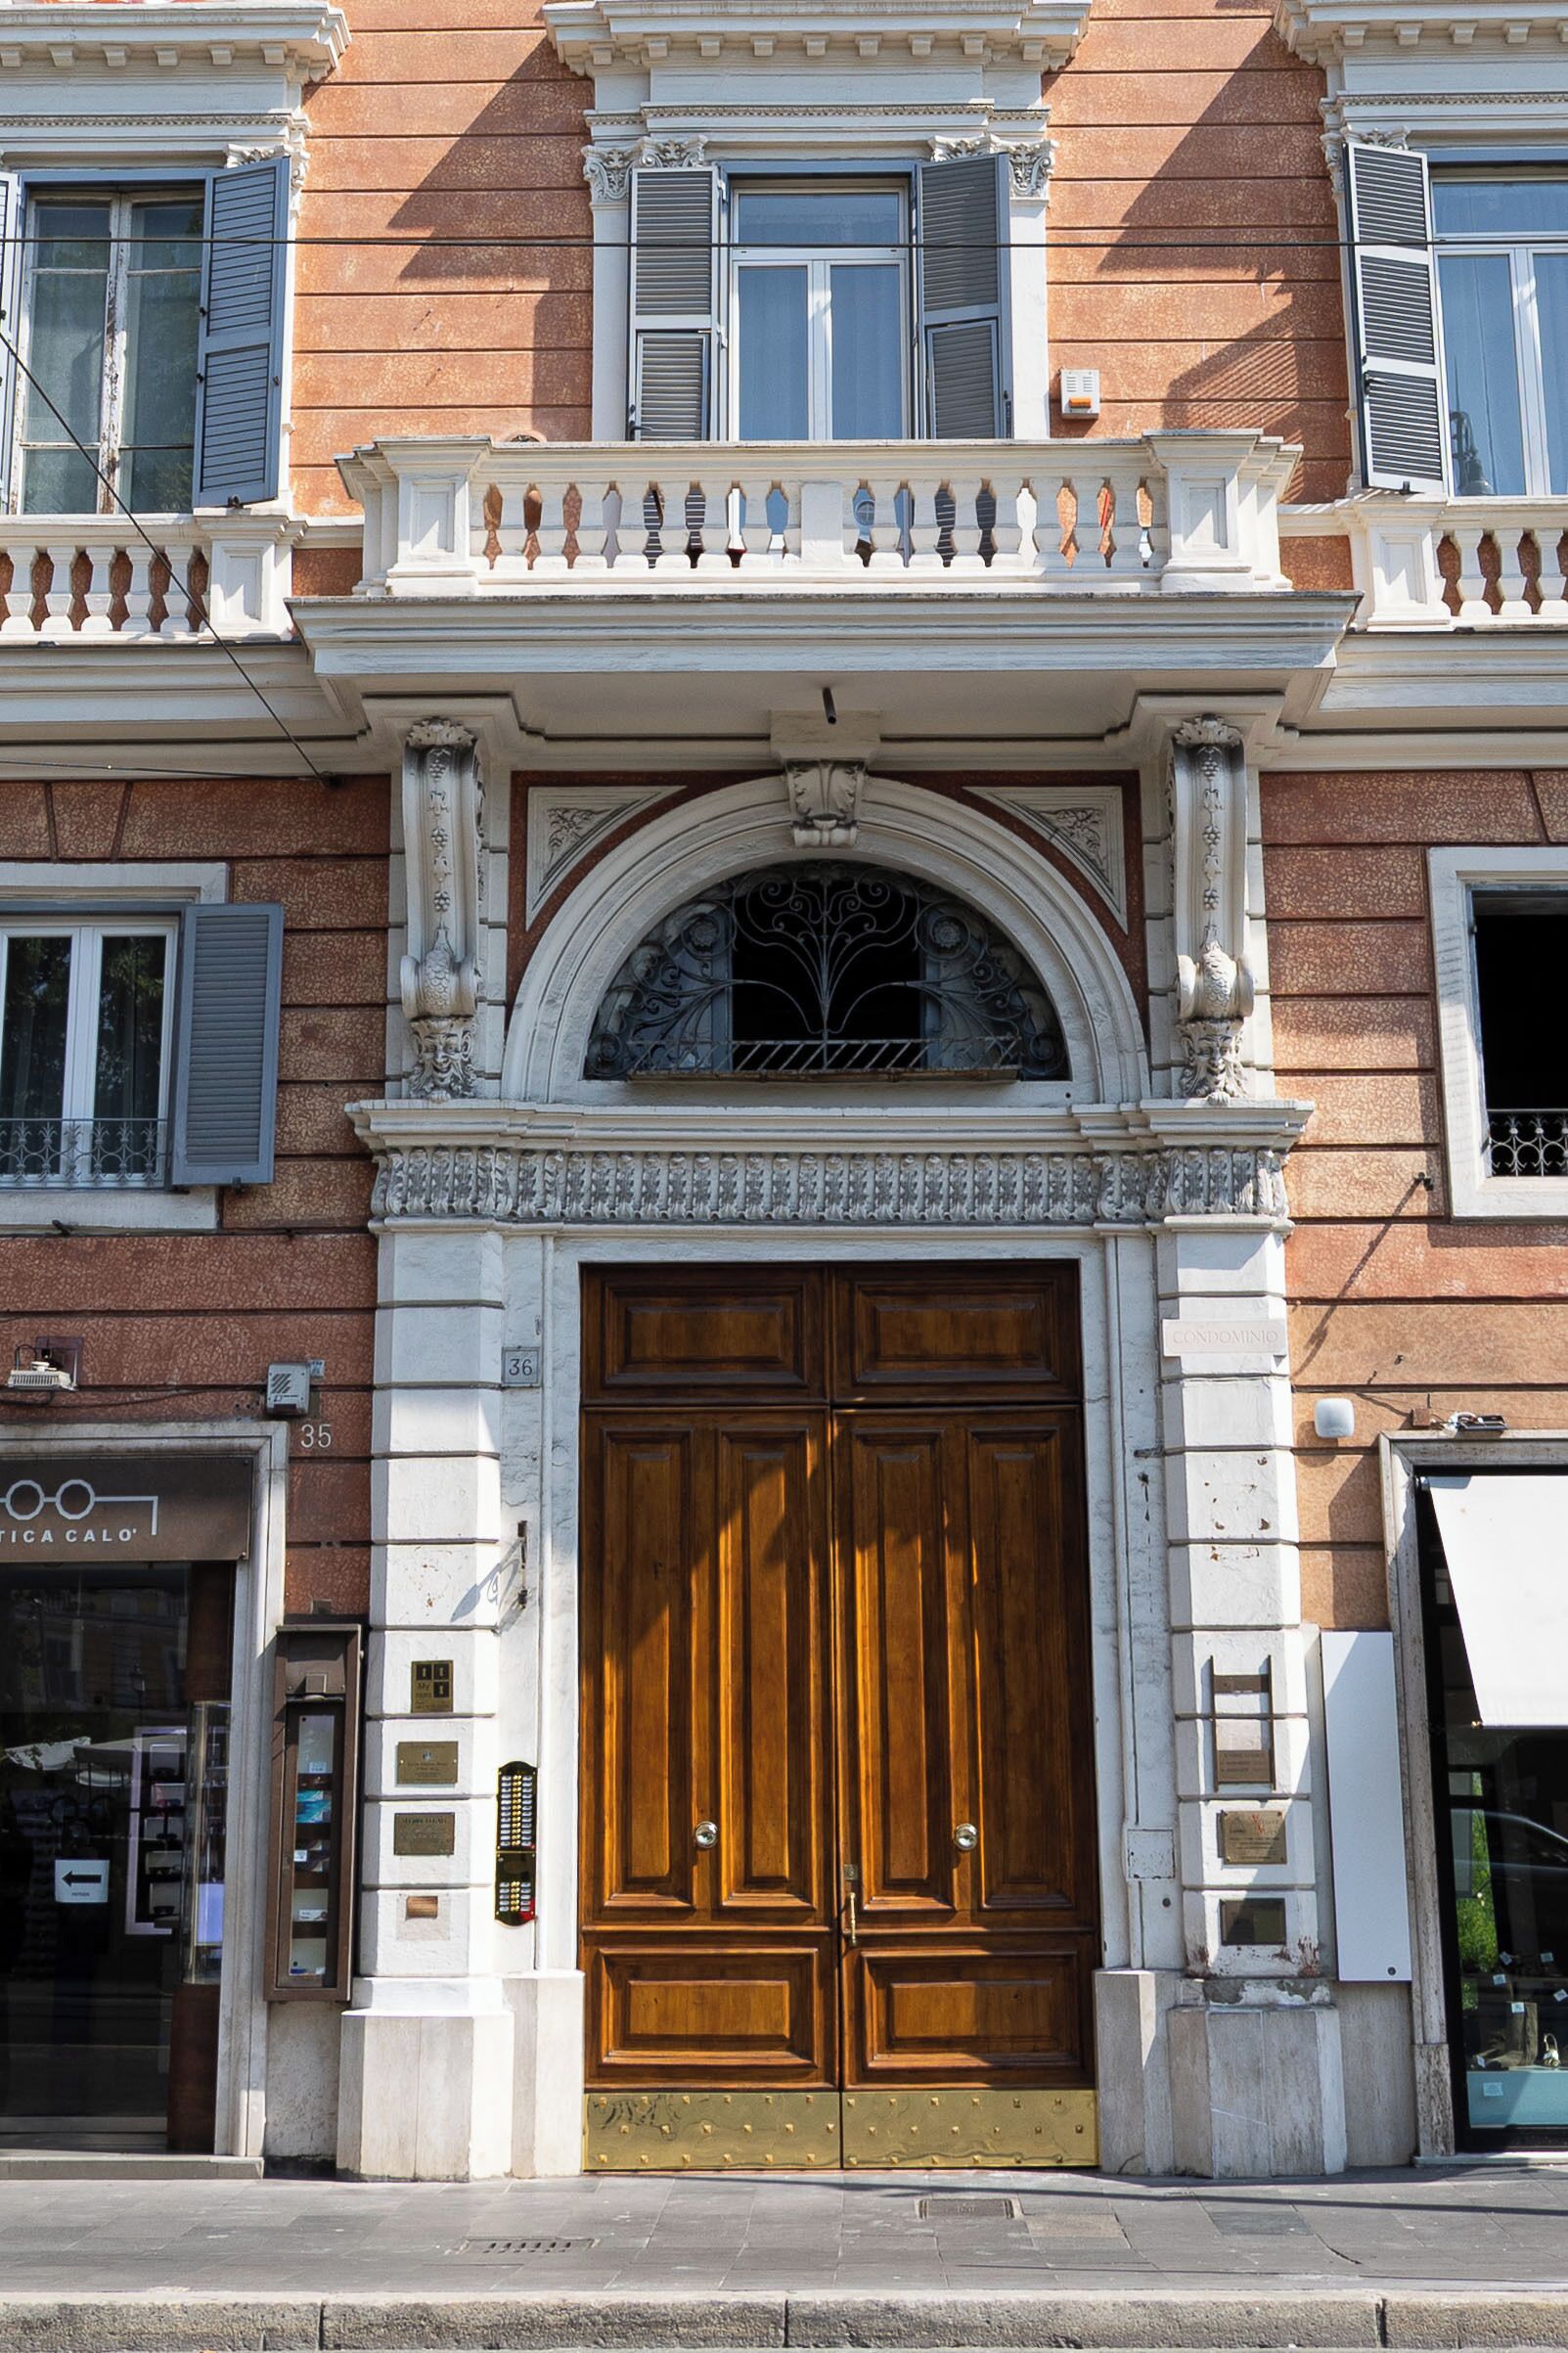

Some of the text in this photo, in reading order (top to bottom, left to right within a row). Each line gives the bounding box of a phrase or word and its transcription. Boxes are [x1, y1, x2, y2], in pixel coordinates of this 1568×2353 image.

[1174, 1330, 1278, 1344] CONDOMINIO
[509, 1358, 533, 1376] 36
[300, 1424, 332, 1448] 35
